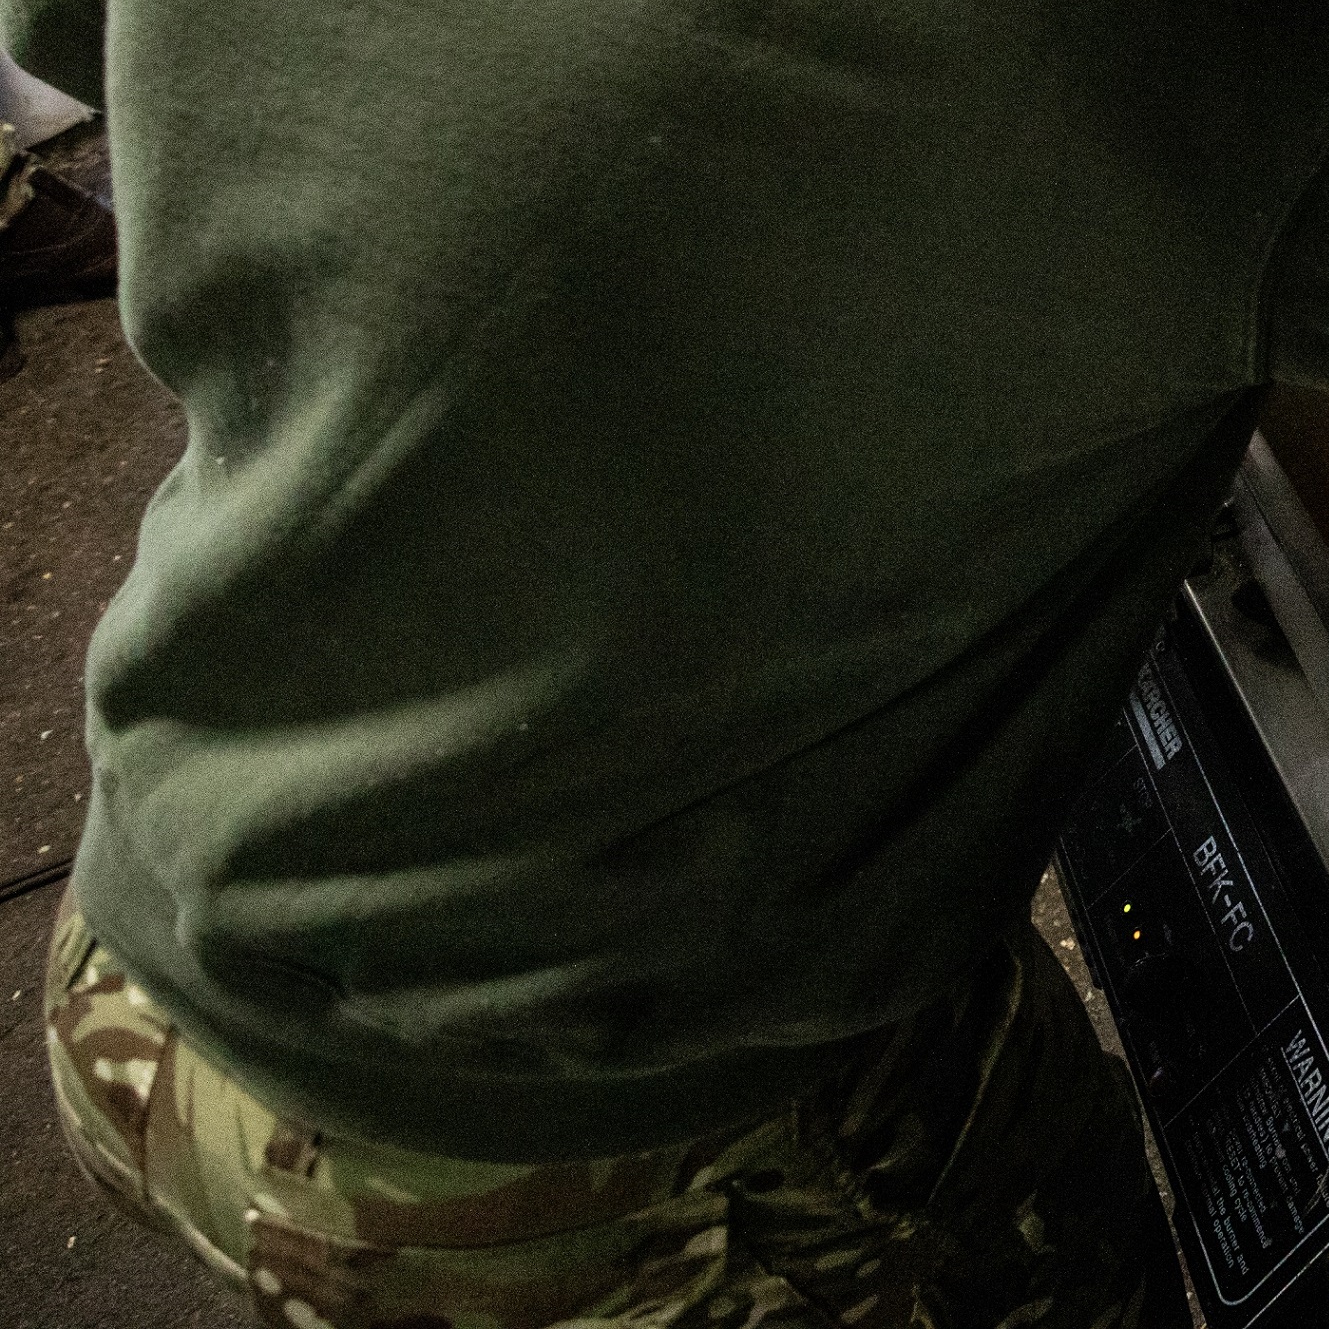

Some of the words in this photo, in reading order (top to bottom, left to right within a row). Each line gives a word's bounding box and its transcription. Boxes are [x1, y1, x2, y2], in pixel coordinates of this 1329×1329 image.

[1194, 835, 1253, 953] BFK-FC
[1221, 1162, 1237, 1199] cooling
[1232, 1195, 1247, 1224] cycle
[1285, 1194, 1304, 1238] damage
[1210, 1216, 1234, 1270] operation
[1215, 1195, 1227, 1218] the
[1222, 1215, 1239, 1254] burner
[1235, 1252, 1248, 1277] and
